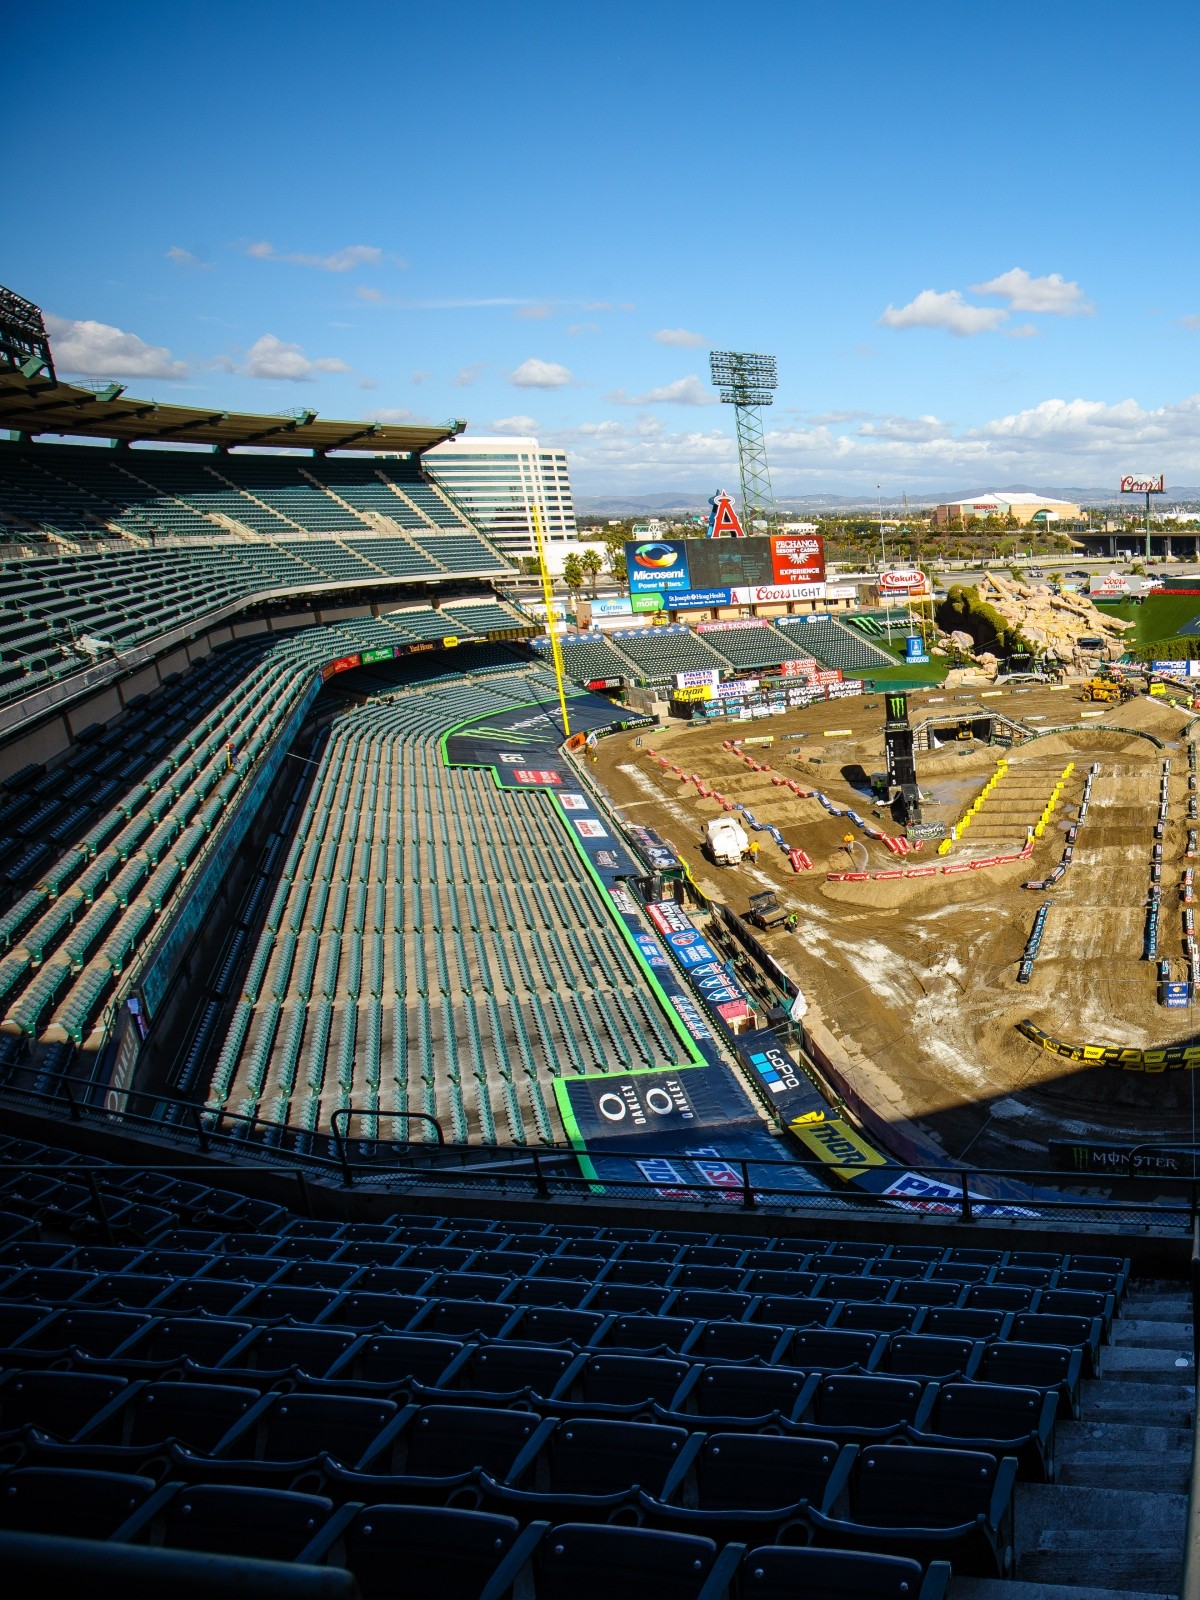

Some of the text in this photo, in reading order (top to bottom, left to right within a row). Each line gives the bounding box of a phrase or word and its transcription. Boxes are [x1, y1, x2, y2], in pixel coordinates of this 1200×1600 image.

[776, 539, 819, 548] PECHANGA
[780, 567, 820, 576] EXPERIENCE
[889, 573, 918, 583] Yakult
[1103, 577, 1127, 585] Coors
[756, 586, 791, 601] Coors
[792, 587, 821, 598] LIGHT
[600, 603, 623, 611] Corona
[636, 600, 659, 608] more
[703, 624, 727, 632] TICKET
[408, 642, 434, 651] Yard House
[716, 682, 746, 690] PARTS
[682, 688, 703, 697] THOR
[718, 690, 748, 698] PARTS
[915, 827, 945, 835] MONSTER
[765, 1049, 800, 1088] GoPro
[666, 1080, 694, 1119] OAKLEY
[621, 1085, 647, 1125] OAKLEY
[810, 1123, 869, 1165] THOR
[1093, 1151, 1179, 1170] MONSTER
